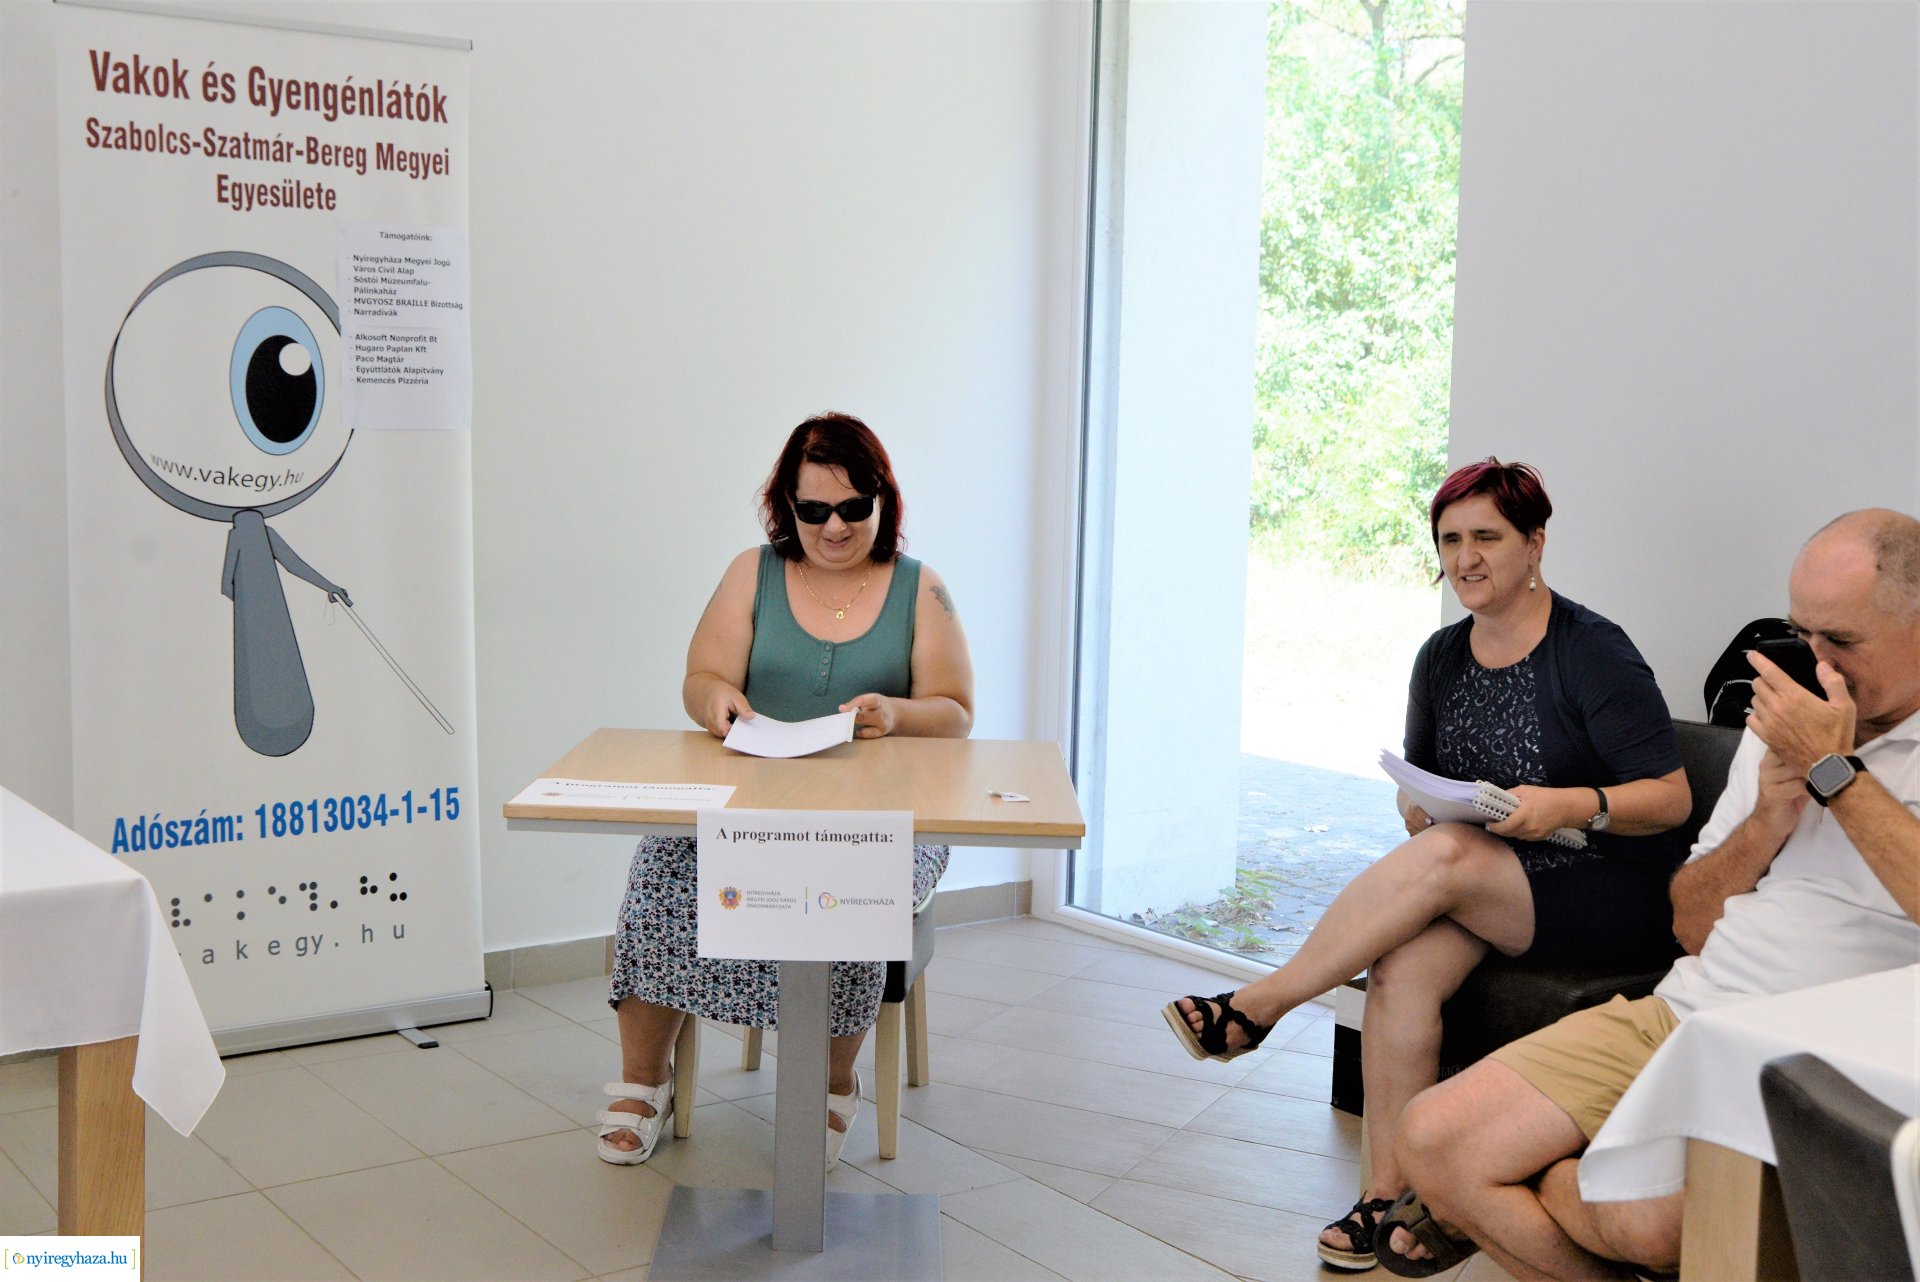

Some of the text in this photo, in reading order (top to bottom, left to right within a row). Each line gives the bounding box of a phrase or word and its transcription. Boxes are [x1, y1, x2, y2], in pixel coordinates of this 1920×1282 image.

[88, 49, 449, 124] Vakok és Gyengénlátók
[85, 116, 450, 181] Szabolcs-Szatmár-Bereg Megyei
[216, 173, 337, 212] Egyesülete
[379, 231, 433, 242] Támogatóink:
[404, 256, 432, 267] Megyei
[353, 265, 415, 276] Város Civil Alap
[353, 286, 397, 295] Pálinkaház
[353, 297, 463, 311] MVGYOSZ BRAILLE Bizottság
[355, 333, 388, 341] Alkosoft
[389, 334, 427, 344] Nonprofit
[355, 344, 385, 353] Hugaro
[386, 345, 413, 354] Paplan
[355, 355, 405, 365] Paco Magtár
[397, 376, 429, 385] Pizzéria
[149, 452, 305, 493] www.vakegy.hu
[111, 786, 461, 855] Adószám: 18813034-1-15
[716, 827, 894, 846] A programot támogatta:
[839, 897, 896, 906] NYÍREGYHÁZA
